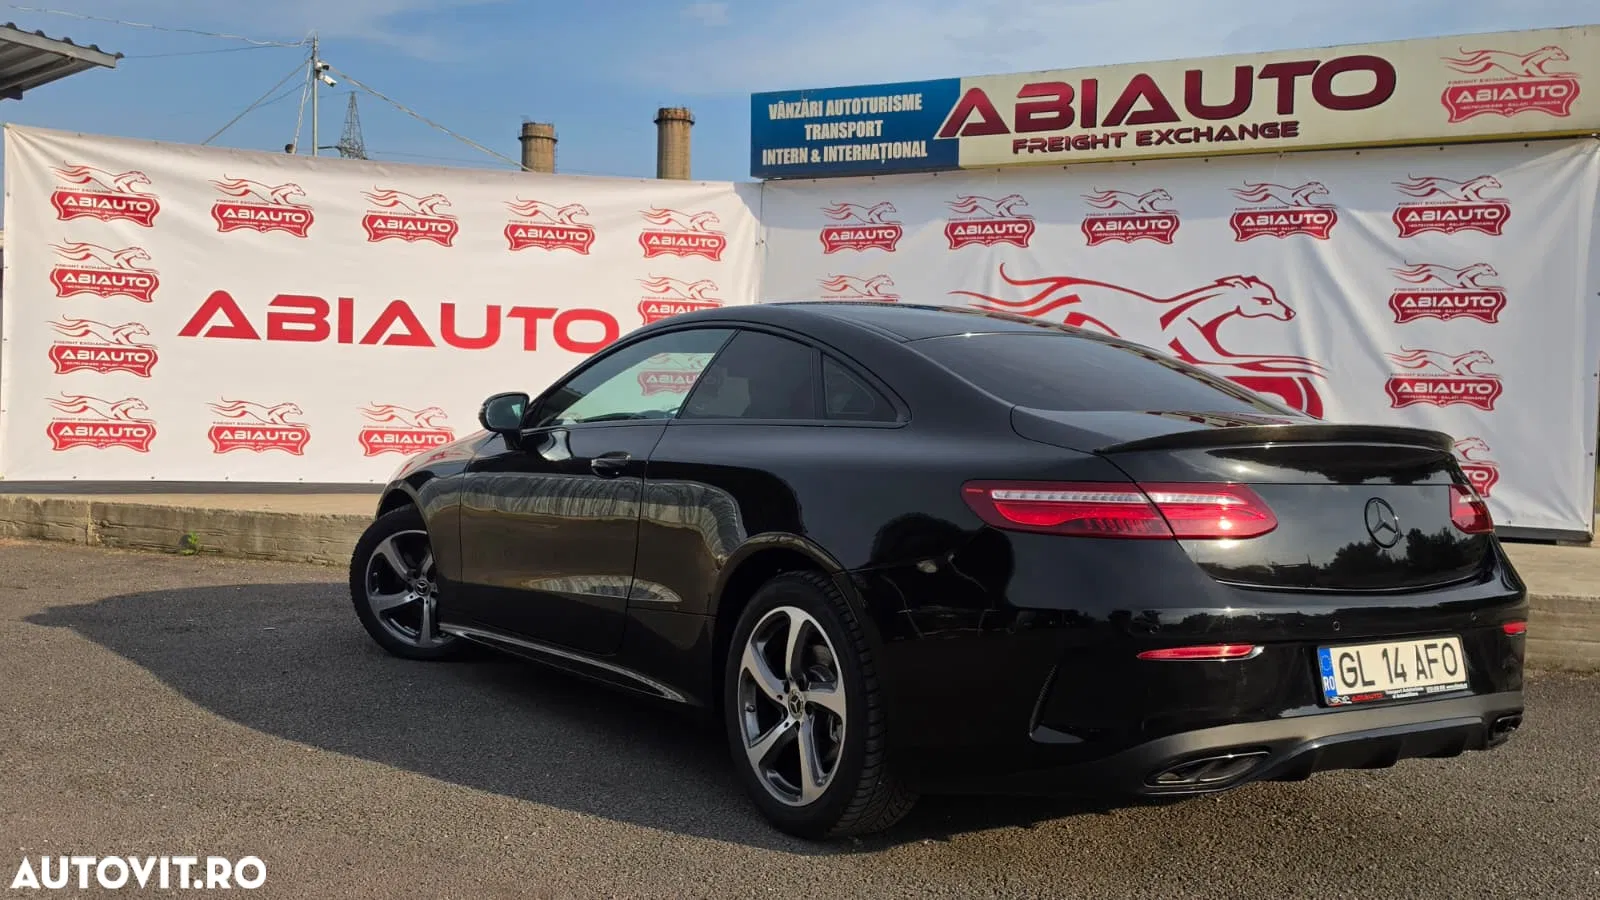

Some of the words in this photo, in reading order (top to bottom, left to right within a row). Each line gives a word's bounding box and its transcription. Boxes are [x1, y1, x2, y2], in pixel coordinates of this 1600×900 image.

[937, 54, 1396, 139] ABIAUTO
[1455, 84, 1569, 104] ABIAUTO
[768, 98, 823, 120] VÂNZĂRI
[825, 93, 923, 117] AUTOTURISME
[804, 119, 884, 141] TRANSPORT
[1012, 131, 1128, 154] FREIGHT
[1135, 120, 1299, 147] EXCHANGE
[762, 147, 808, 166] INTERN
[811, 148, 822, 164] &
[62, 194, 151, 212] ABIAUTO
[222, 207, 306, 223] ABIAUTO
[1240, 212, 1328, 226] ABIAUTO
[1404, 207, 1500, 222] ABIAUTO
[372, 217, 451, 233] ABIAUTO
[952, 222, 1028, 235] ABIAUTO
[1091, 218, 1172, 231] ABIAUTO
[513, 227, 588, 242] ABIAUTO
[648, 235, 719, 248] ABIAUTO
[828, 229, 896, 241] ABIAUTO
[61, 272, 150, 288] ABIAUTO
[1400, 295, 1497, 308] ABIAUTO
[177, 289, 619, 354] ABIAUTO
[60, 348, 149, 363] ABIAUTO
[1397, 381, 1493, 394] ABIAUTO
[58, 426, 147, 439] ABIAUTO
[218, 429, 302, 442] ABIAUTO
[369, 434, 447, 445] ABIAUTO
[1339, 650, 1375, 688] GL
[1382, 647, 1407, 684] 14
[1414, 642, 1458, 680] AFO
[1323, 676, 1335, 691] RO
